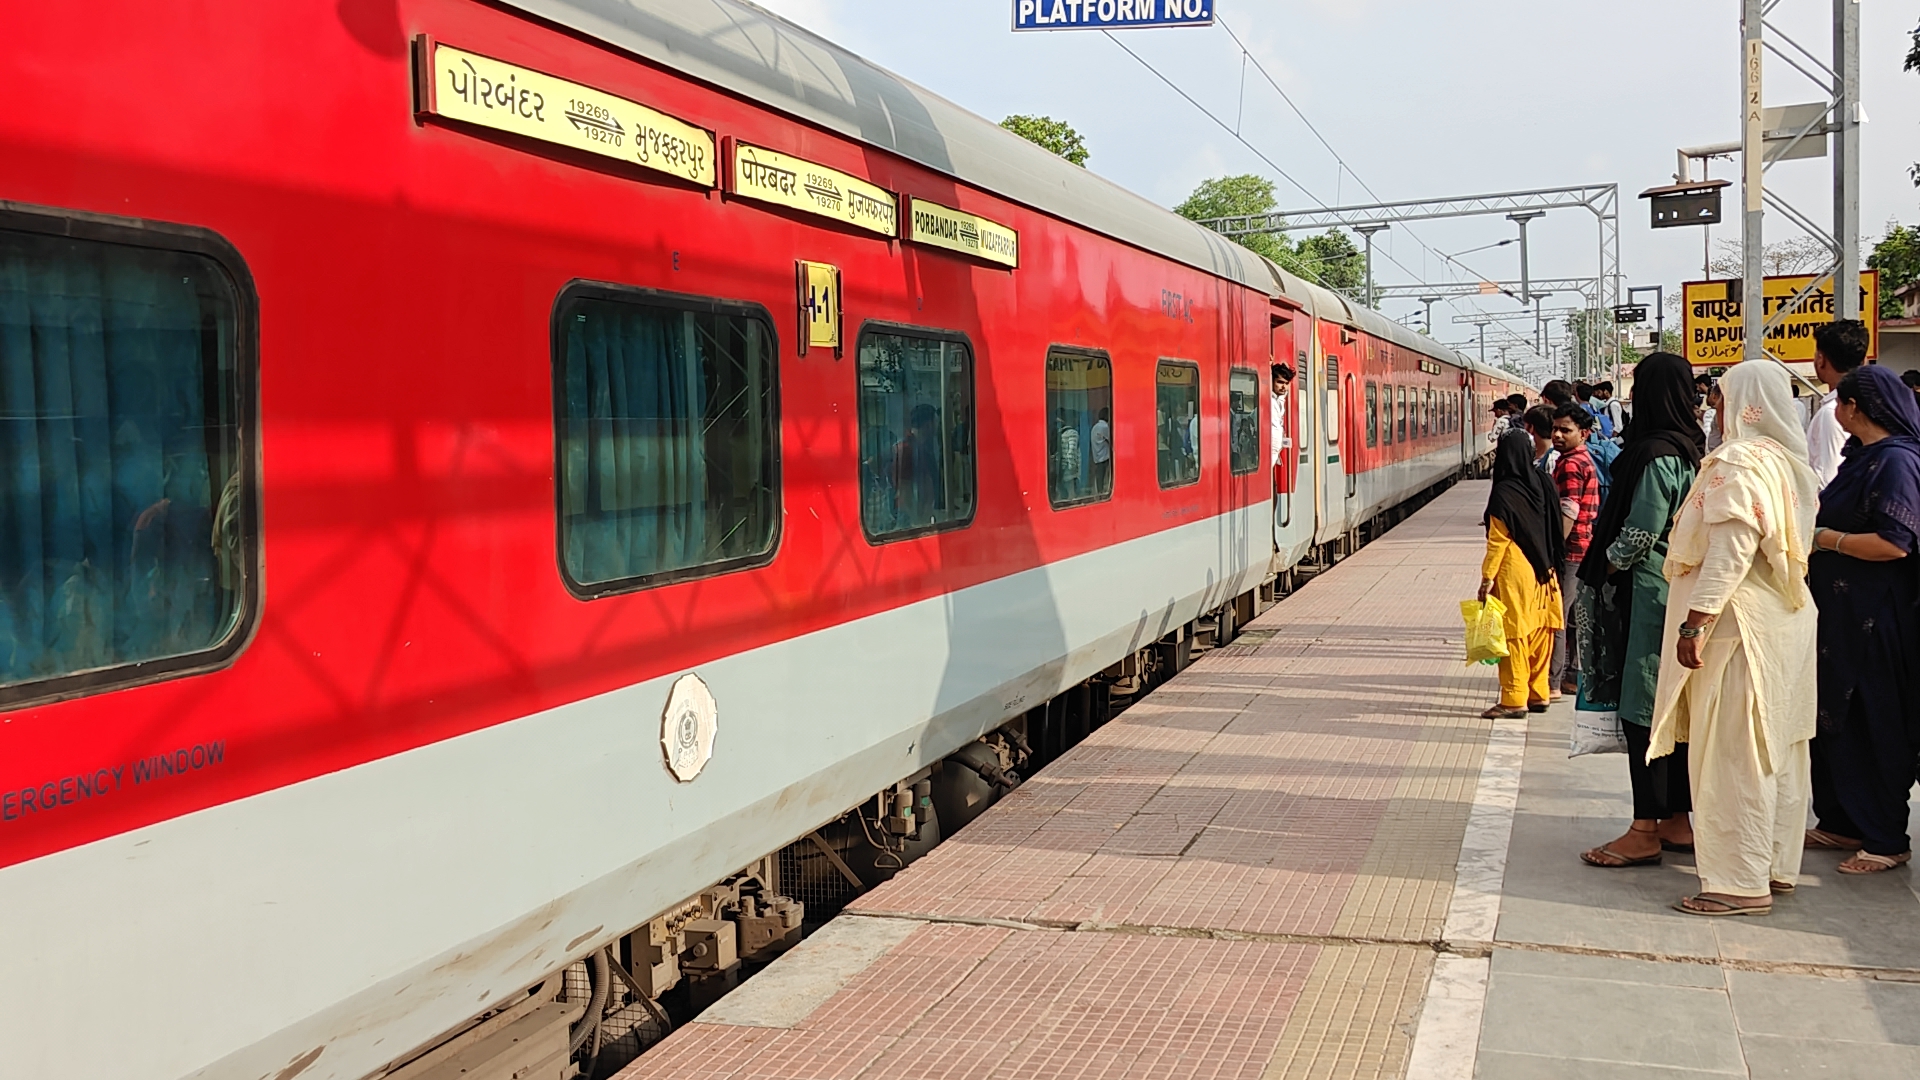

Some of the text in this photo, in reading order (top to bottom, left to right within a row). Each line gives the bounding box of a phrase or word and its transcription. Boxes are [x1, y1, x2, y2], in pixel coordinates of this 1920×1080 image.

[1019, 0, 1208, 24] PLATFORM NO.
[448, 58, 545, 122] પોરબંદર
[568, 98, 610, 122] 19269
[583, 126, 623, 147] 19270
[741, 148, 797, 196] पोरबंदर
[806, 172, 833, 190] 19269
[816, 196, 841, 212] 19270
[914, 210, 958, 241] PORBANDAR
[132, 739, 226, 786] WINDOW
